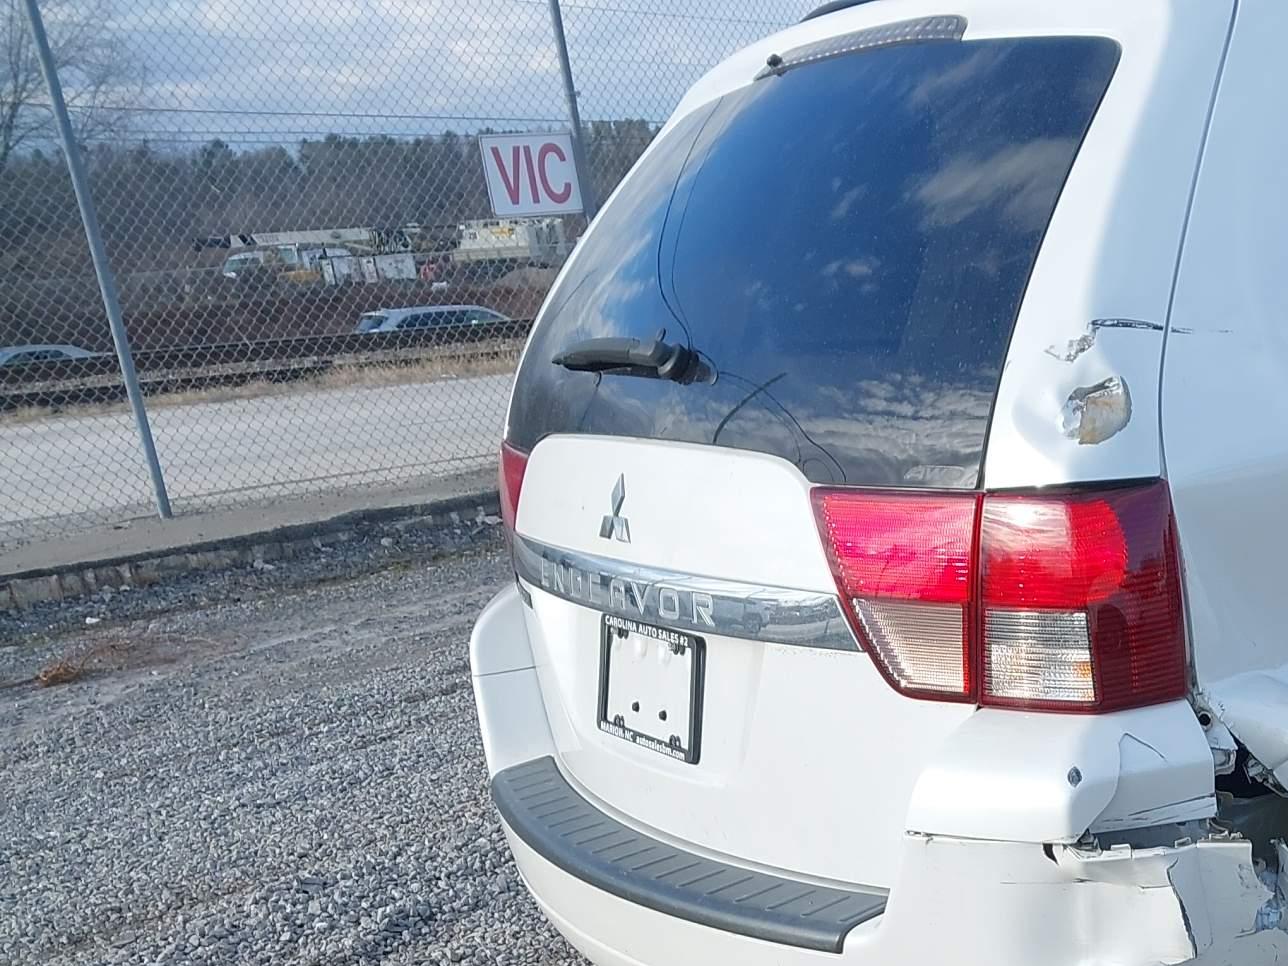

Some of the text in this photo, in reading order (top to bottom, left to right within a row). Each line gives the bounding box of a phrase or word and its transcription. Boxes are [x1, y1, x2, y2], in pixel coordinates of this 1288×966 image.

[490, 143, 571, 205] VIC
[605, 615, 637, 632] CAROLINA
[638, 623, 658, 638] AUTO
[657, 629, 679, 644] SALES
[624, 729, 634, 742] NC
